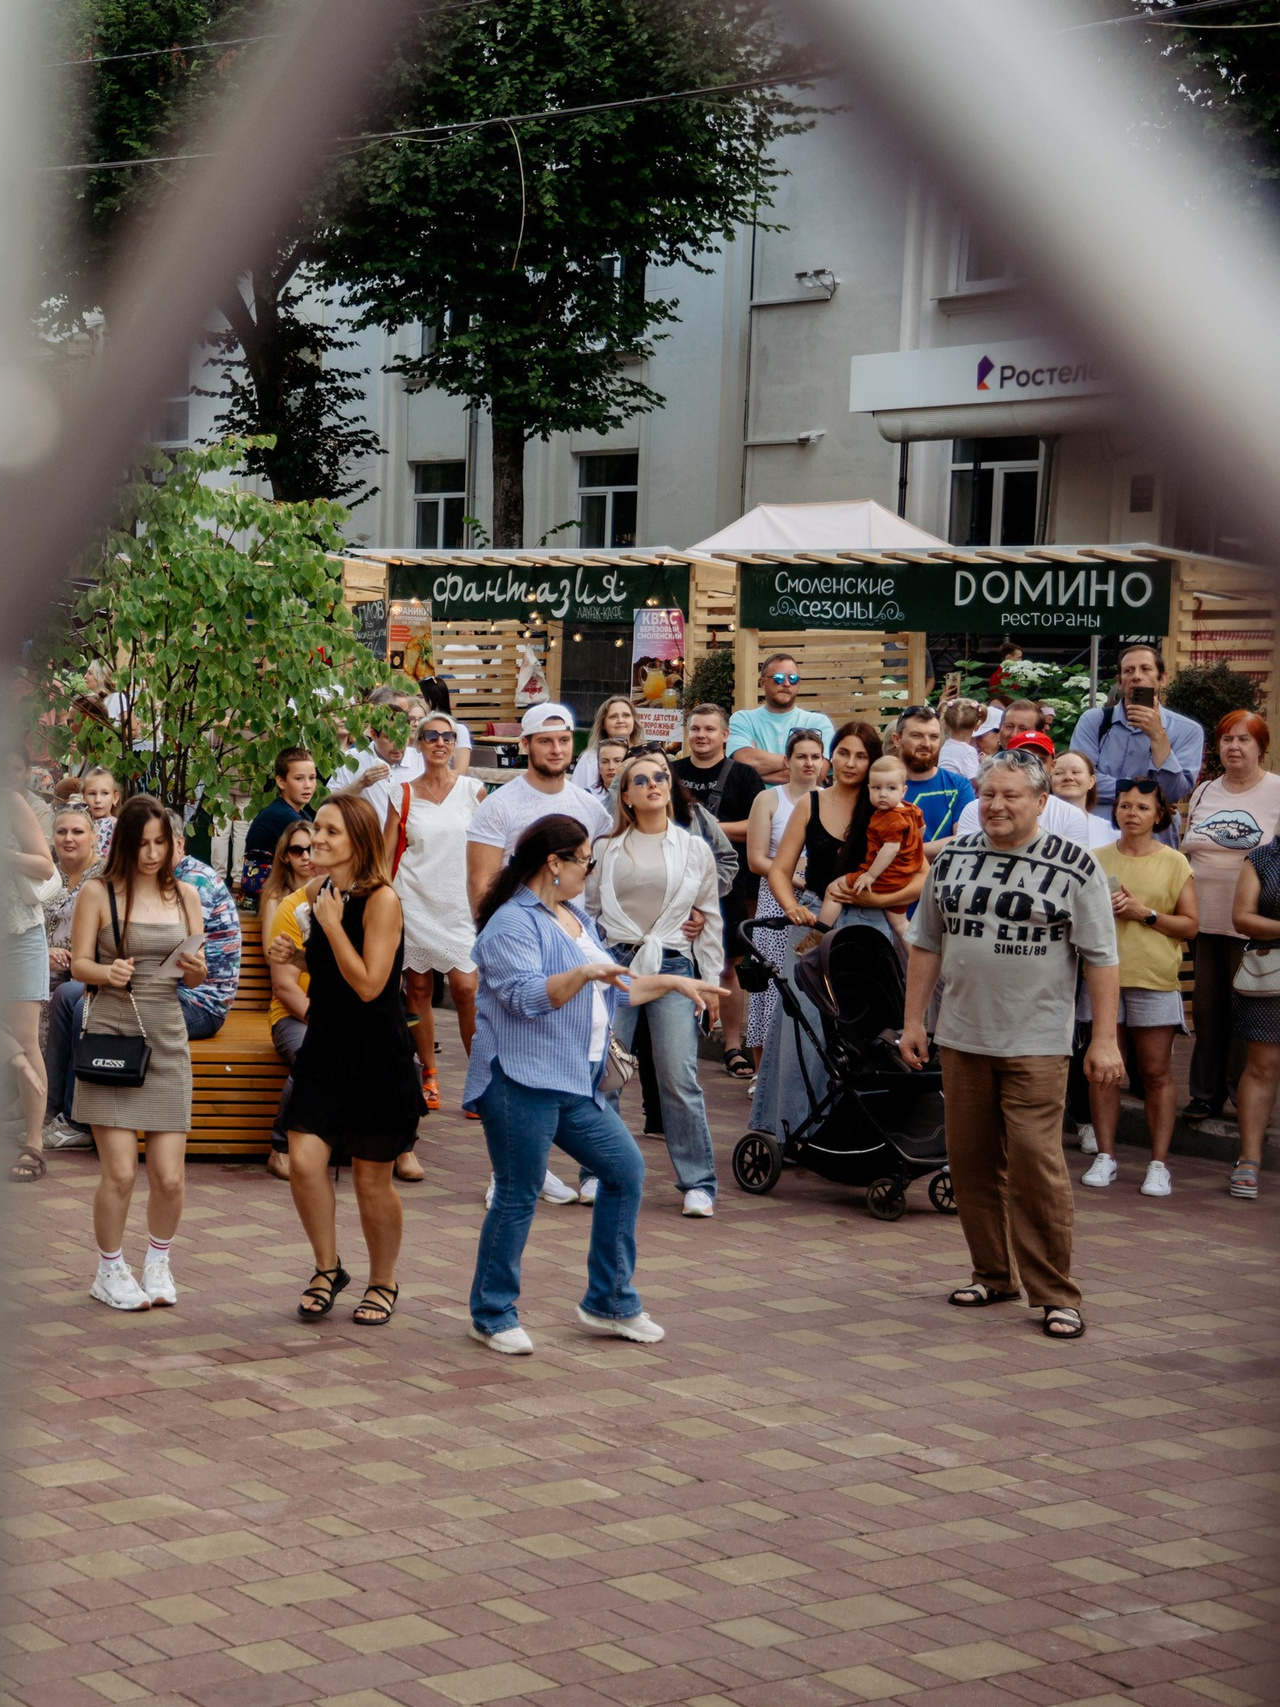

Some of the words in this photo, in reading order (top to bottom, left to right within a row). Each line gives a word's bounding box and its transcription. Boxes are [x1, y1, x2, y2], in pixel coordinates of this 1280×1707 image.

[999, 362, 1102, 389] Ростел
[775, 571, 895, 596] Смоленские
[358, 600, 385, 622] ПЛОВ
[391, 606, 430, 617] РАНИКИ
[799, 600, 873, 619] сезоны
[642, 612, 678, 625] КВАС
[1001, 612, 1100, 628] рестораны
[637, 632, 682, 640] СМОЛЕНСКИЙ
[935, 884, 1072, 924] NJOY
[997, 923, 1065, 942] LIFE
[994, 943, 1047, 956] SINCE/89
[92, 1058, 125, 1068] GUESS
